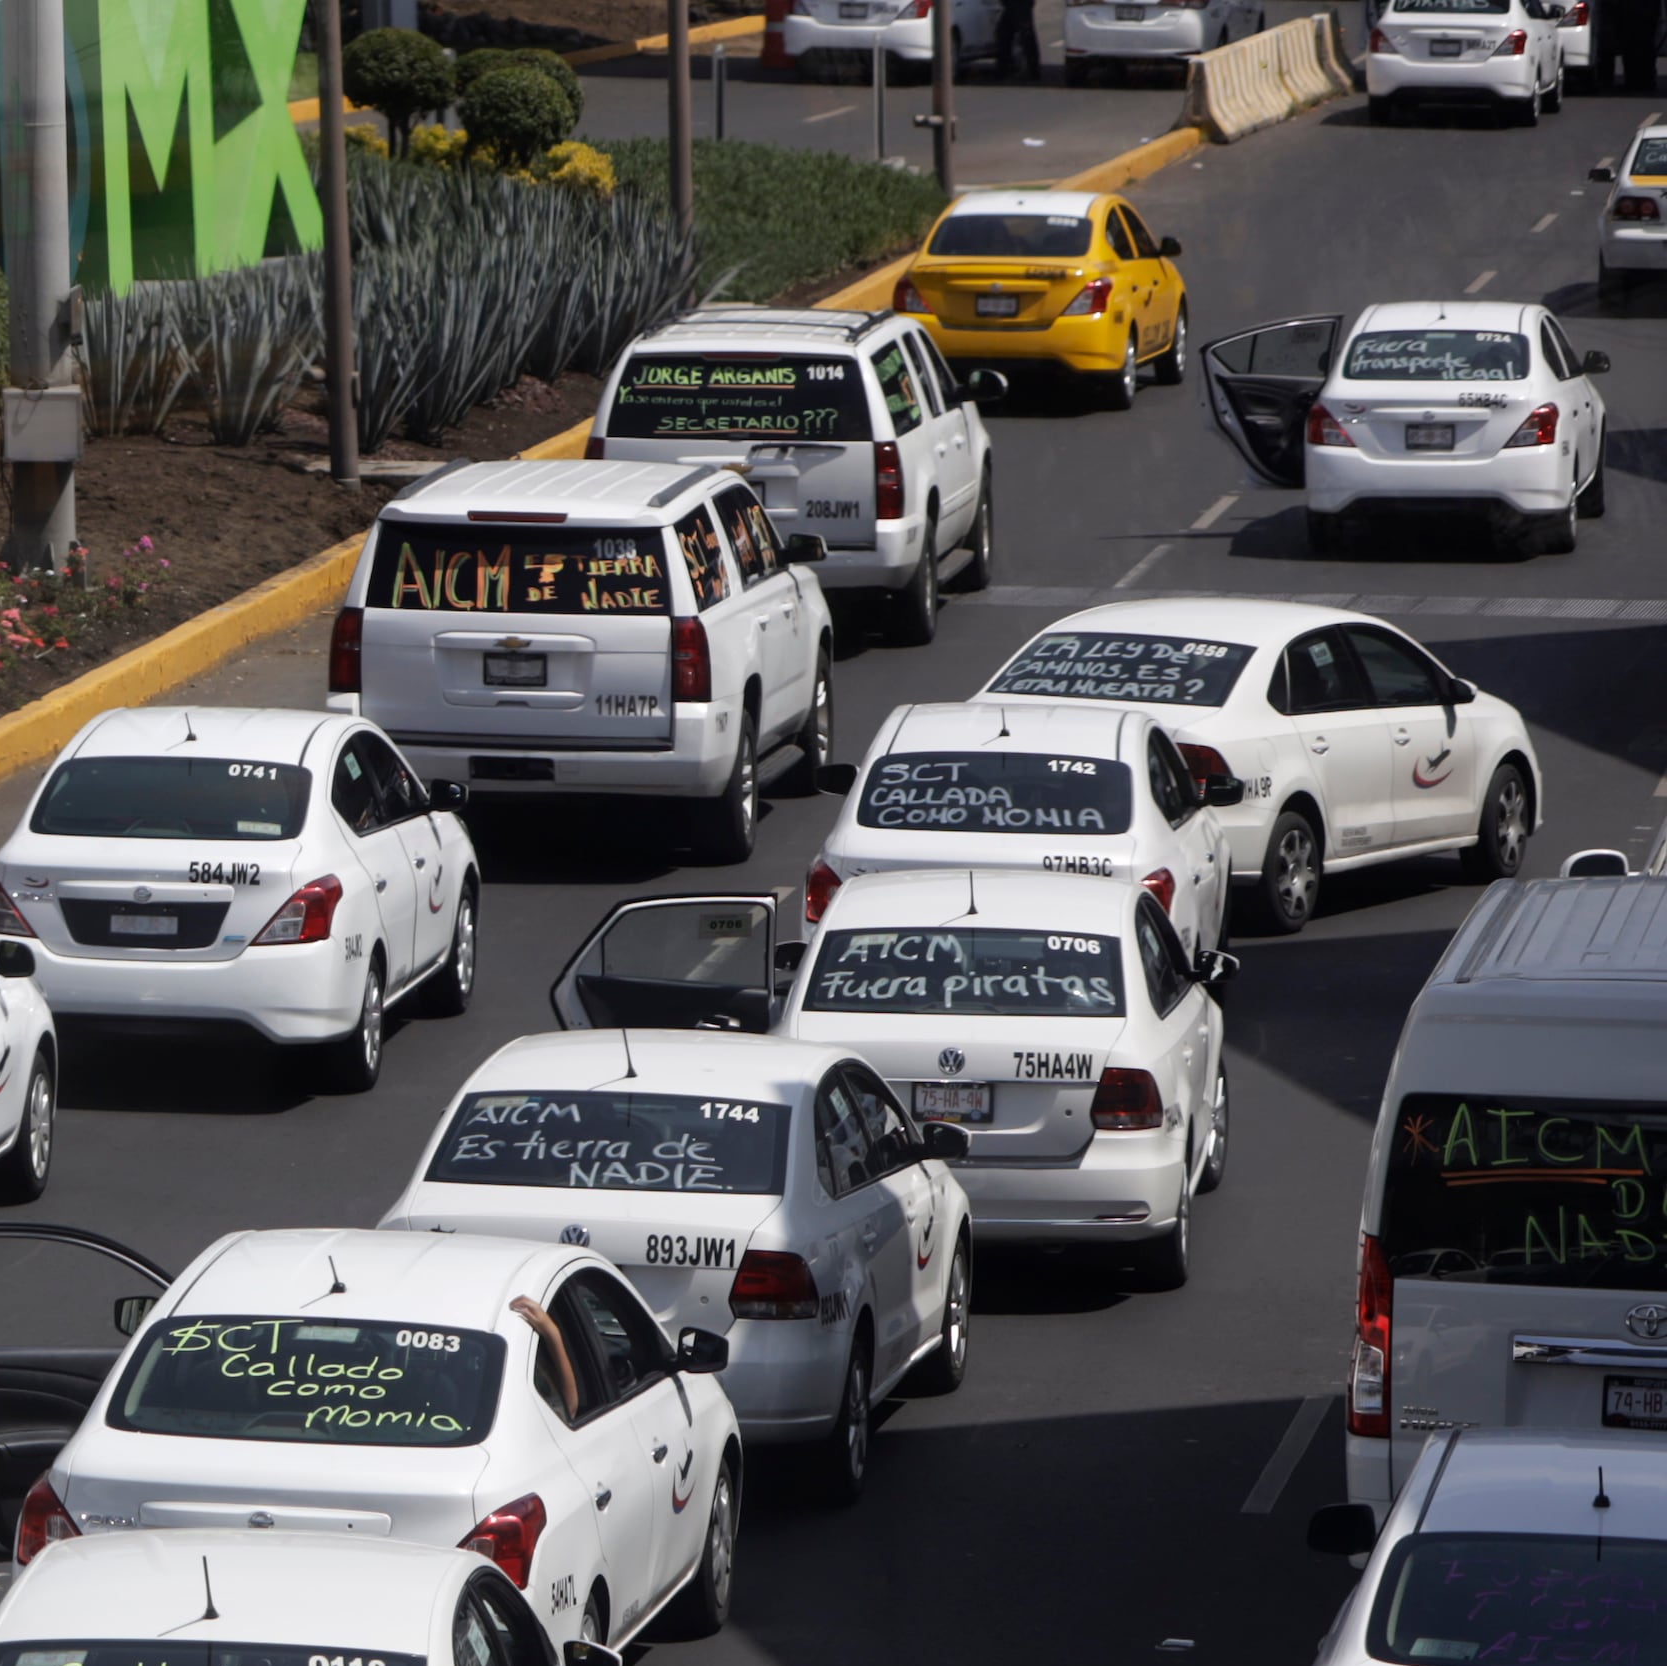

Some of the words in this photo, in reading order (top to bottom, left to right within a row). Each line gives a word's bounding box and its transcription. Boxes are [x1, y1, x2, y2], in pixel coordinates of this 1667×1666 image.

[806, 364, 845, 380] 1014
[1351, 352, 1469, 373] transporte
[633, 365, 703, 385] JORGE
[709, 365, 797, 384] ARGANIS
[805, 500, 860, 519] 208JW1
[594, 538, 637, 560] 1038
[392, 542, 511, 612] AICM
[581, 578, 664, 610] NADIE
[1083, 641, 1146, 658] LEY
[1182, 643, 1229, 658] 0558
[1137, 664, 1182, 681] ES
[994, 678, 1073, 693] LETRA
[595, 695, 658, 718] 11HA7P
[228, 764, 278, 780] 0741
[881, 762, 969, 785] SCT
[1047, 760, 1097, 775] 1742
[870, 786, 1013, 808] CALLADA
[982, 808, 1105, 829] MOMIA
[188, 862, 260, 886] 584JW2
[1043, 856, 1113, 877] 97HB3C
[838, 934, 963, 963] AICM
[1047, 935, 1101, 955] 0706
[820, 971, 927, 999] Fuera
[943, 966, 1117, 1008] piratas
[1013, 1052, 1093, 1079] 75HA4W
[466, 1101, 581, 1127] AICM
[700, 1102, 760, 1123] 1744
[451, 1134, 505, 1162] Es
[513, 1130, 631, 1160] tierra
[653, 1133, 716, 1162] de
[1442, 1103, 1652, 1176] AICM
[646, 1234, 737, 1267] 893JW1
[396, 1329, 461, 1352] 0083
